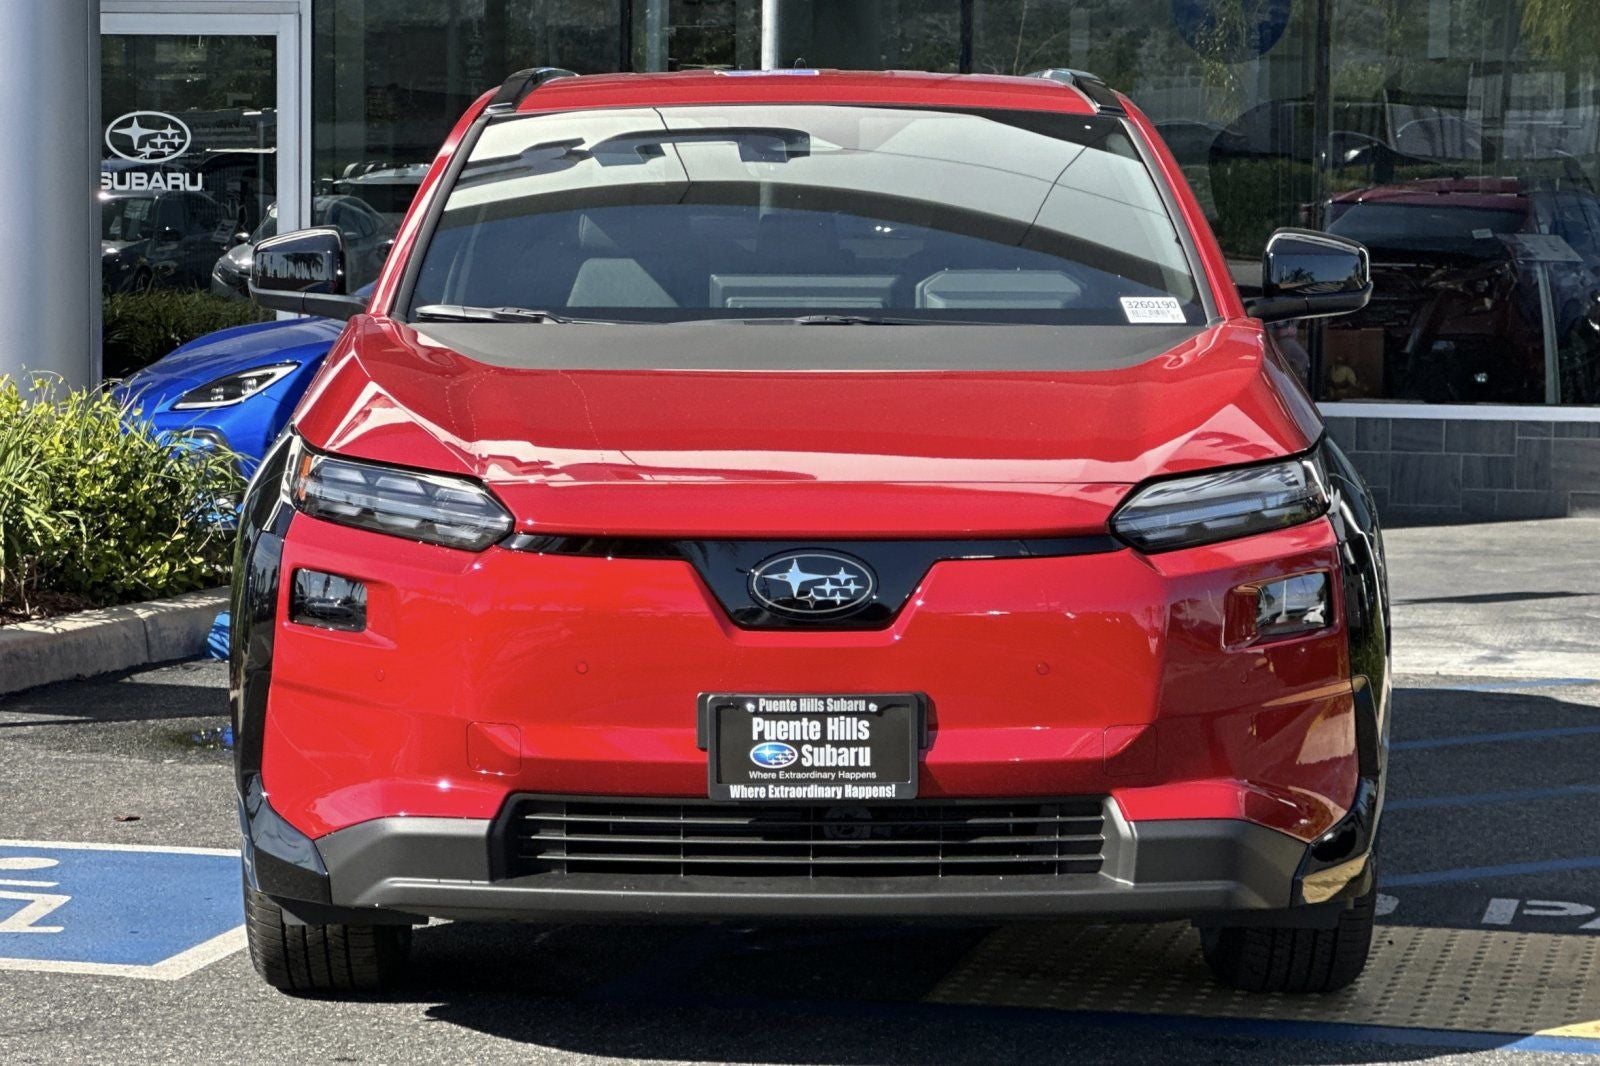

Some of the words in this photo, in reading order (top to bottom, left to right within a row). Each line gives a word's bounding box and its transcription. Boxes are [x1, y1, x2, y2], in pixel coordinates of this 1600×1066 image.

[101, 172, 203, 191] SUBARU
[758, 698, 798, 713] Puente
[799, 698, 825, 712] Hills
[826, 698, 866, 712] Subaru
[752, 717, 821, 741] Puente
[826, 716, 870, 741] Hills
[801, 744, 871, 767] Subaru
[749, 771, 777, 779] Where
[779, 771, 836, 780] Extraordinary
[838, 771, 877, 780] Happens
[729, 785, 767, 799] Where
[768, 785, 842, 799] Extraordinary
[844, 784, 896, 799] Happens!
